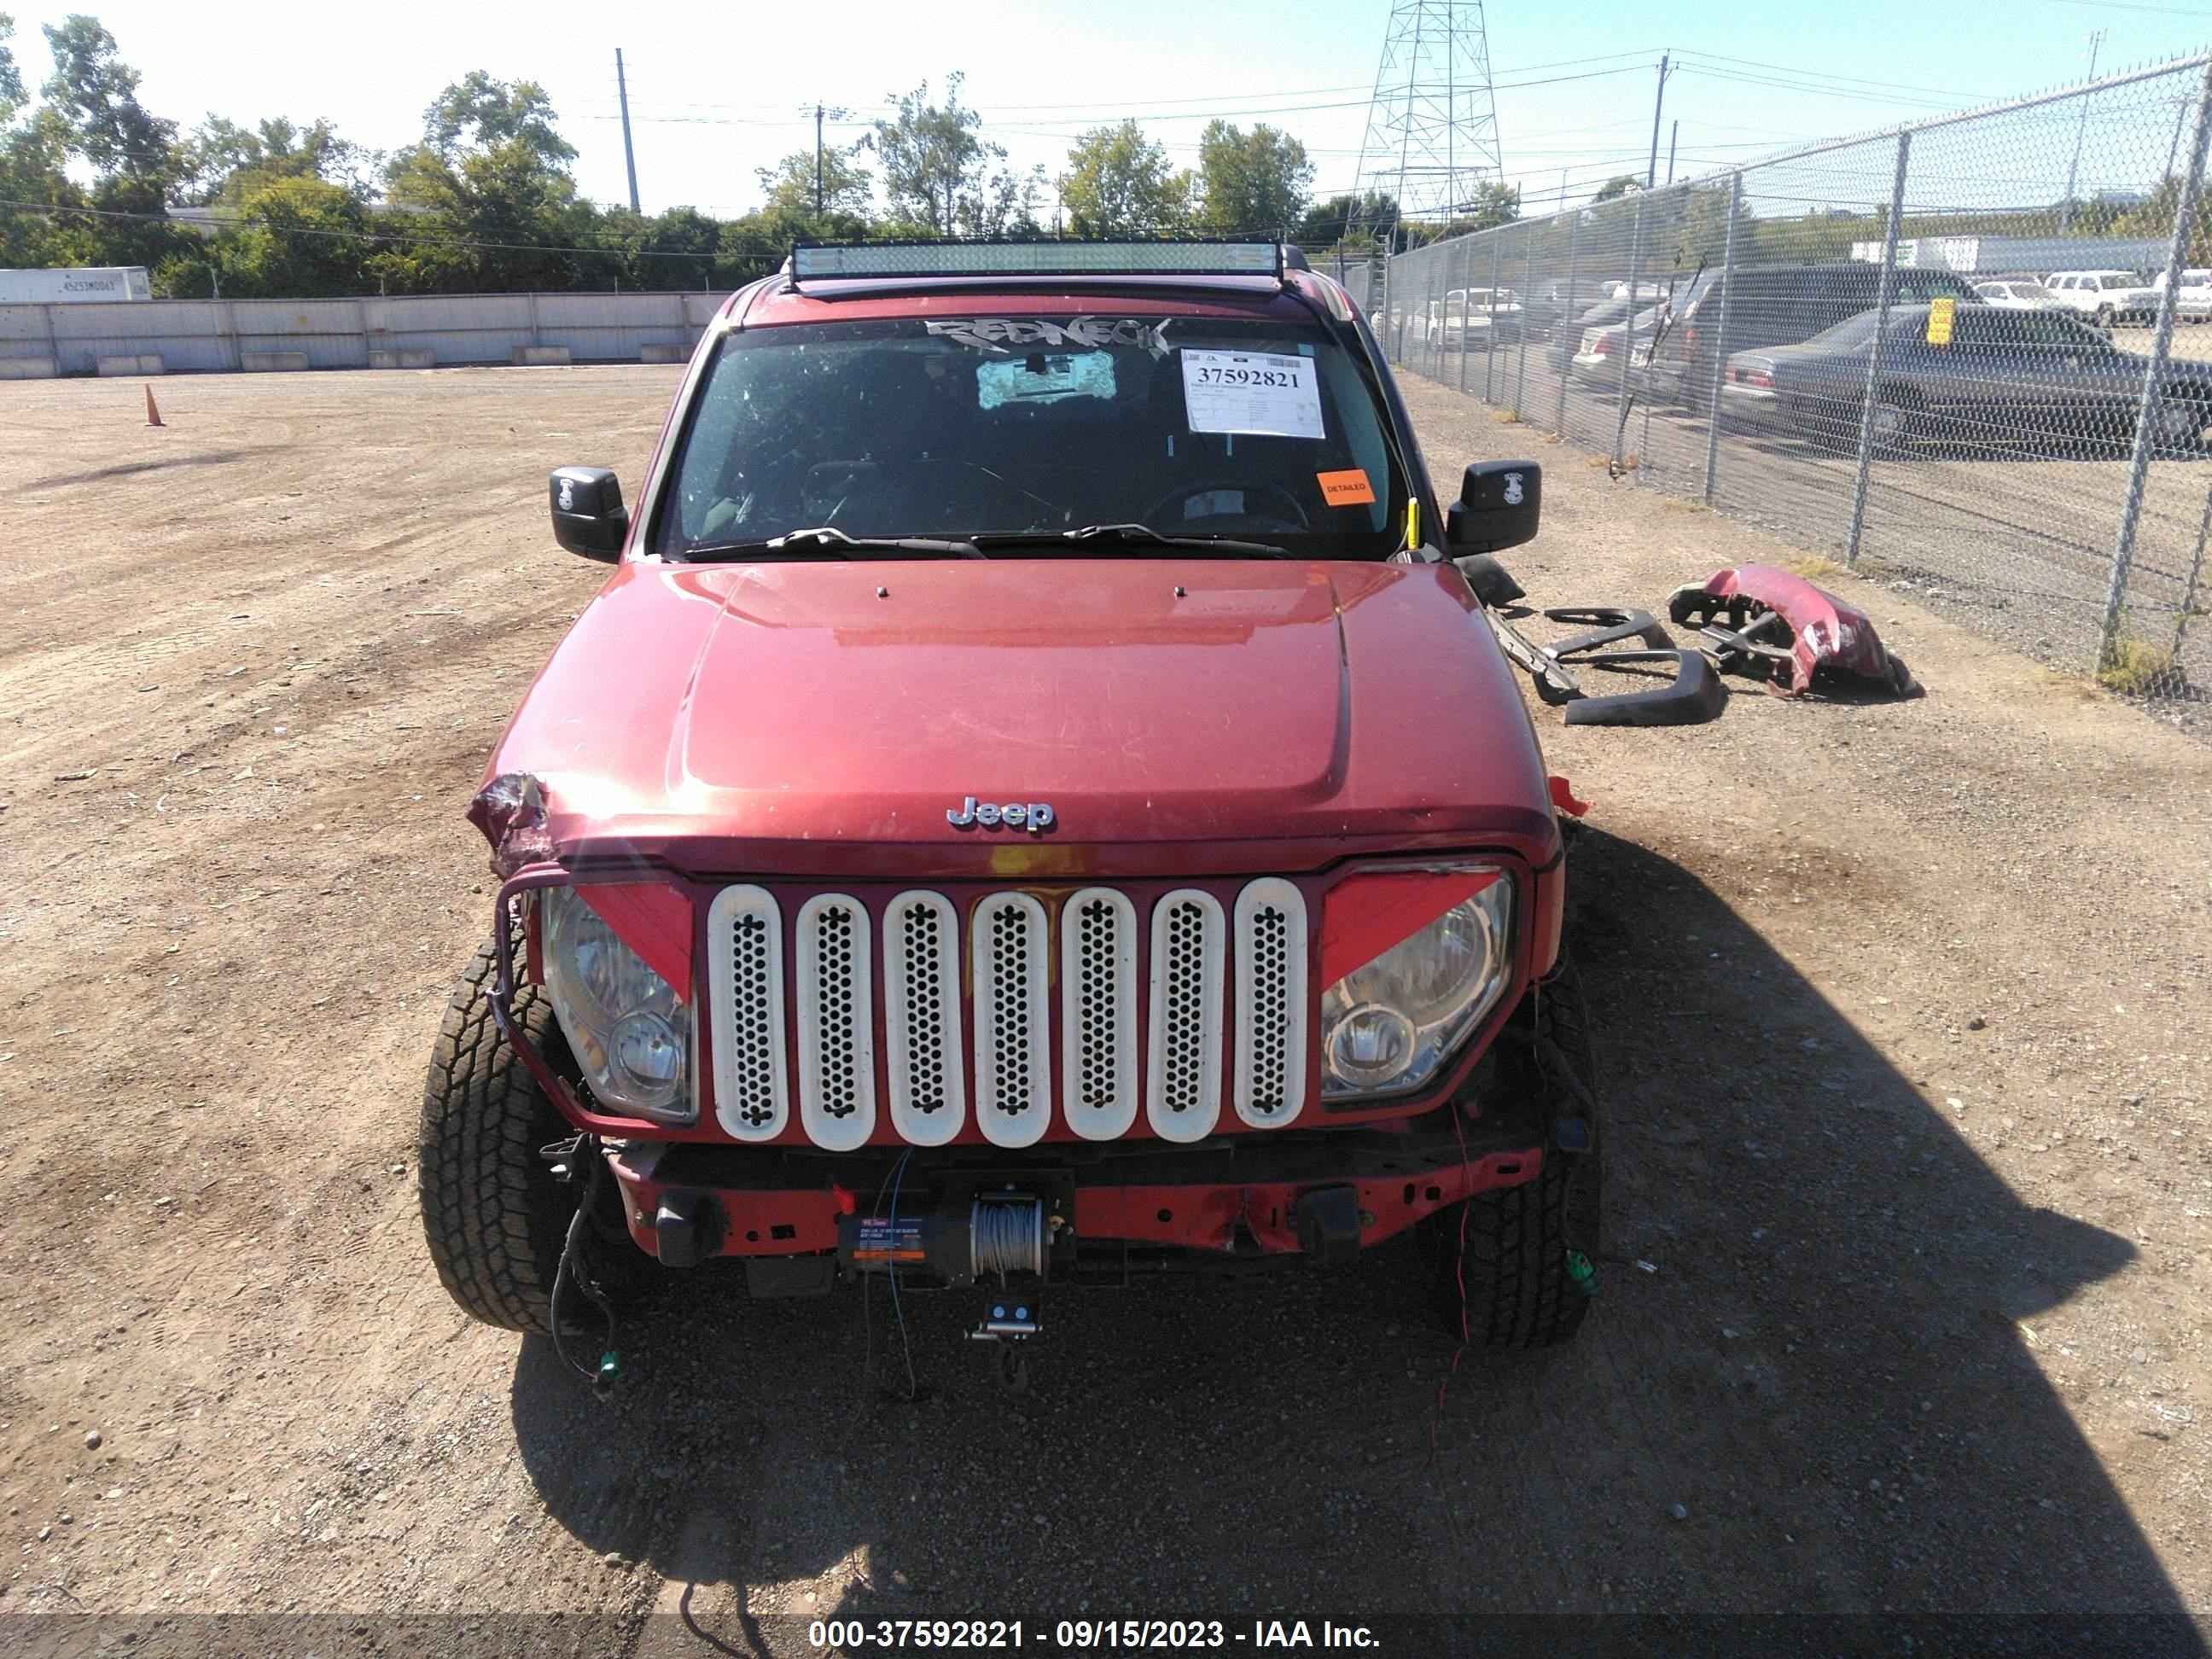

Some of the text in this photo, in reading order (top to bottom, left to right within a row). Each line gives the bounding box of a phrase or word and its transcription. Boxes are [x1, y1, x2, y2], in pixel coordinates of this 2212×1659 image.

[1197, 368, 1300, 388] 37592821
[1327, 483, 1366, 492] DETAILED
[946, 796, 1054, 831] Jeep
